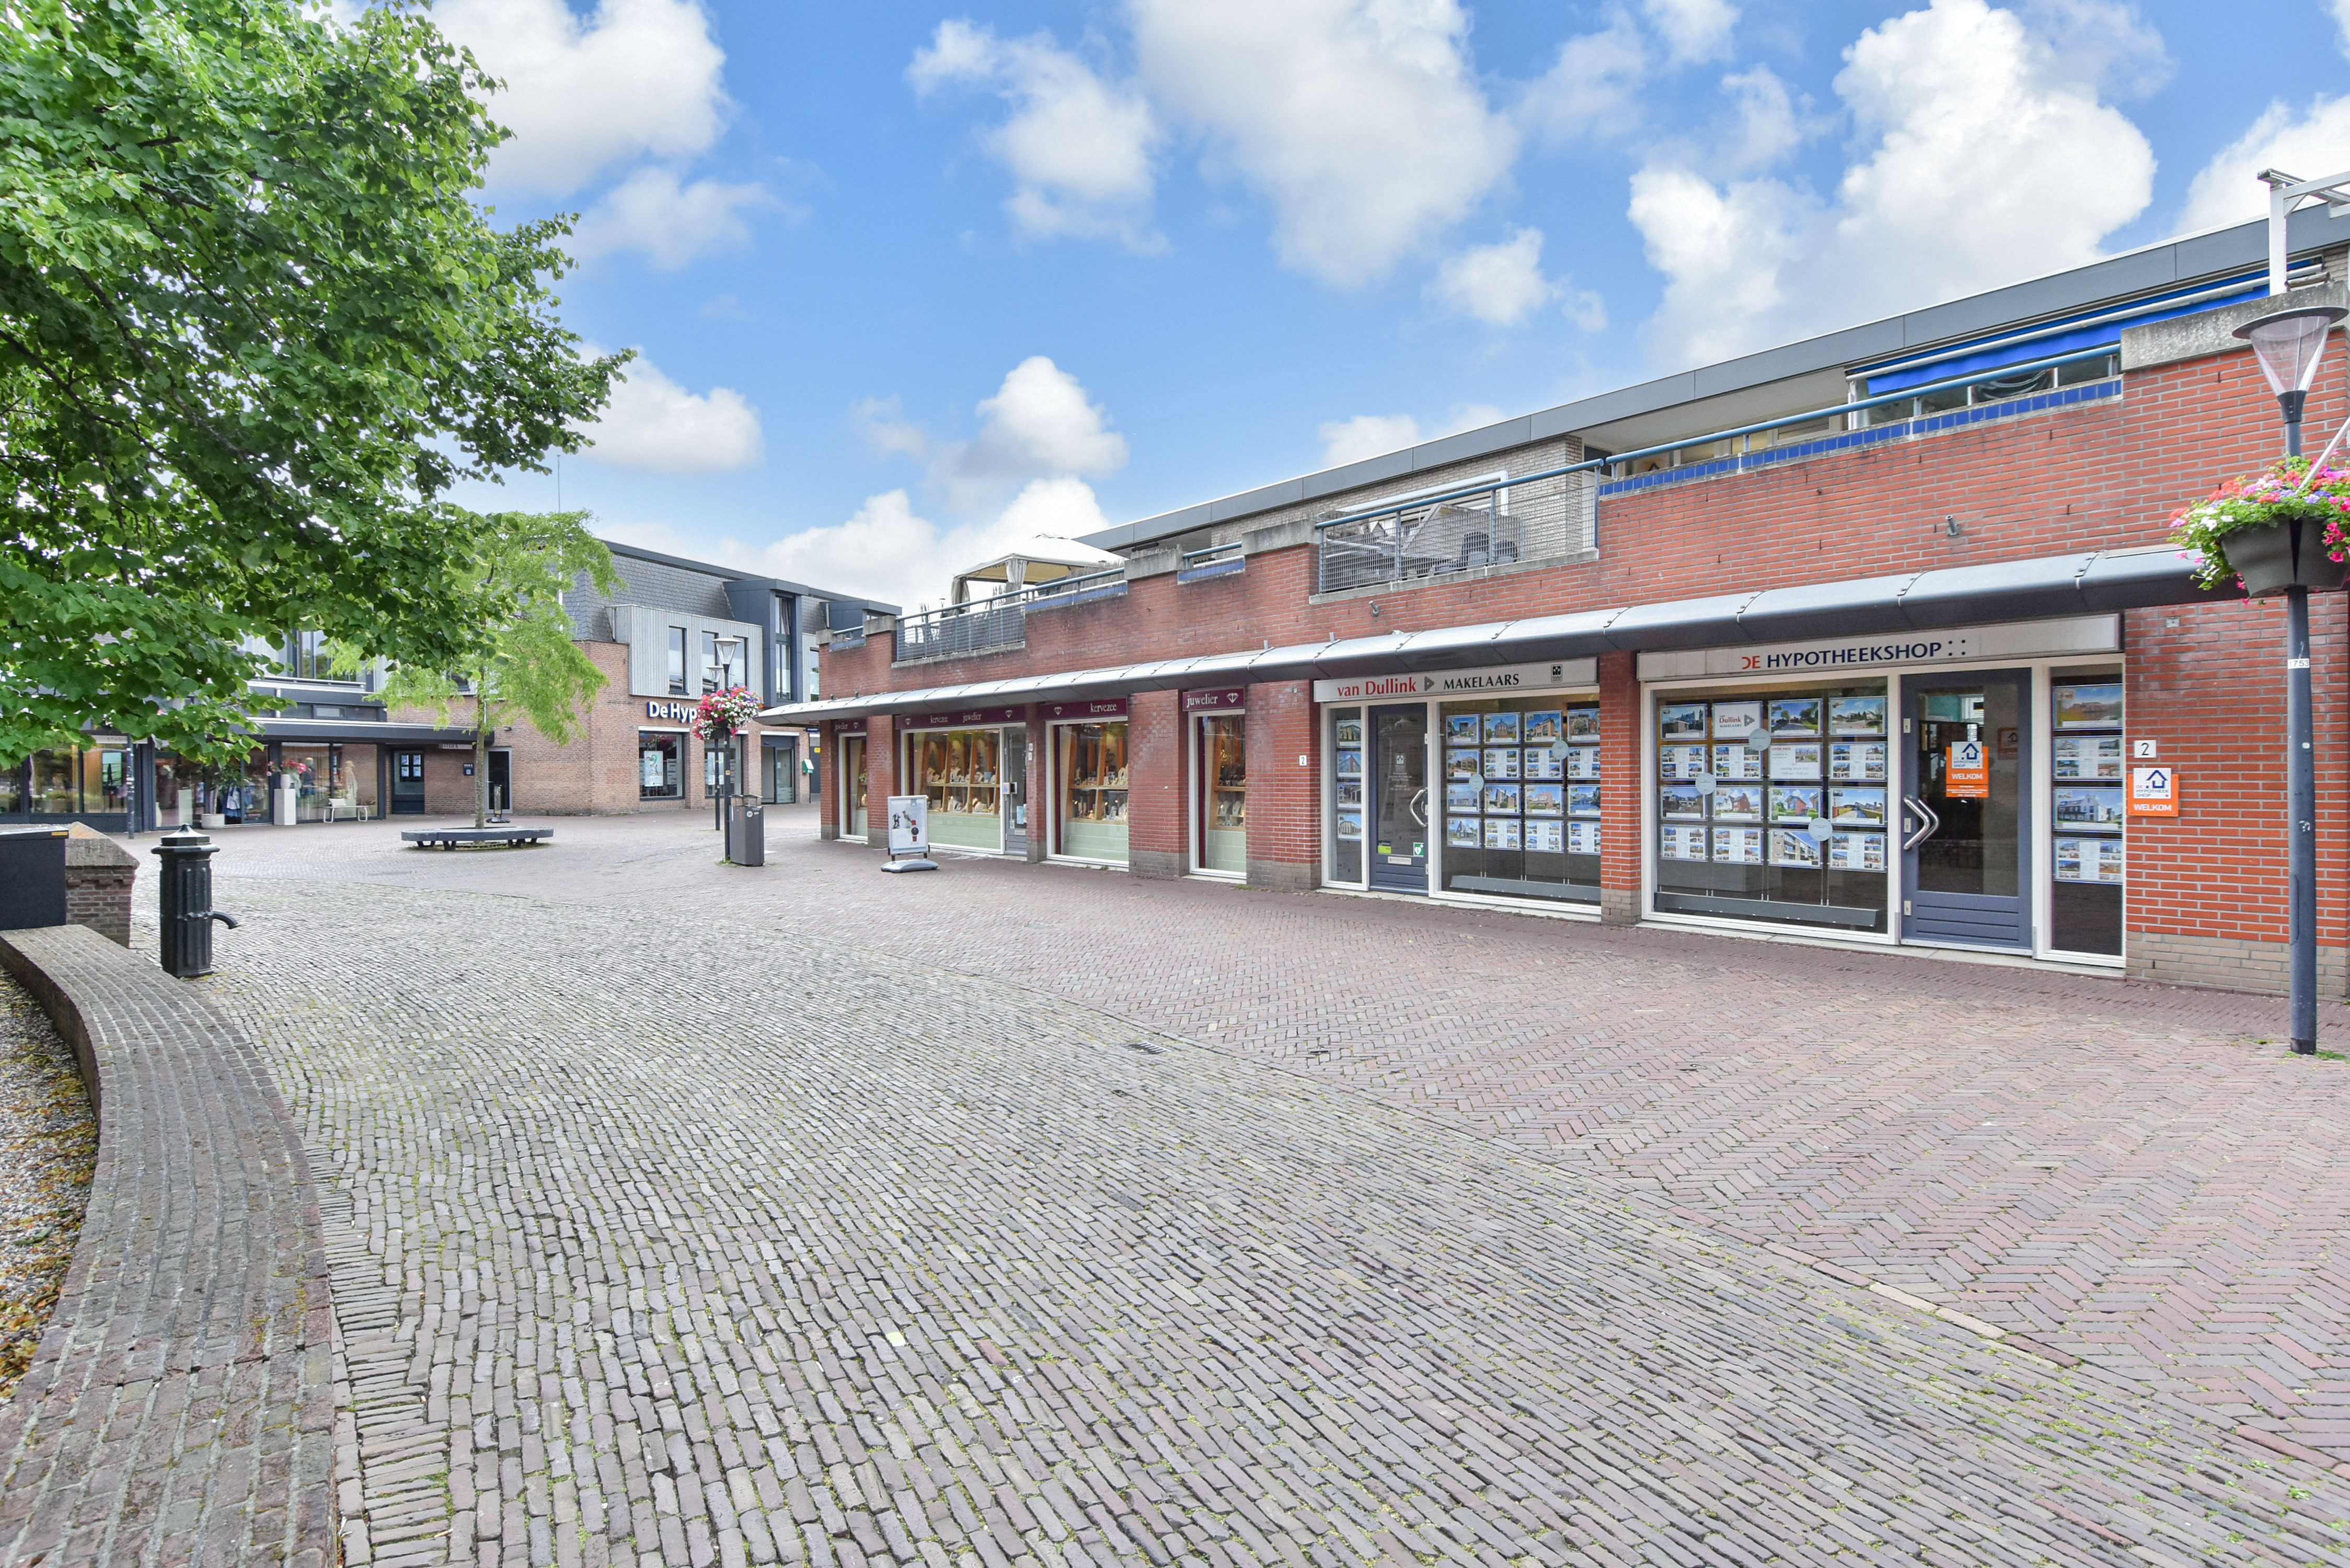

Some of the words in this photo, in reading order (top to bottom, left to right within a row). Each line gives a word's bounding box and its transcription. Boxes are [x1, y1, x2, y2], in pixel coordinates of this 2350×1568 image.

[1767, 642, 1942, 668] HYPOTHEEKSHOP
[1338, 685, 1360, 697] van
[1365, 676, 1416, 695] Dullink
[1443, 674, 1519, 690] MAKELAARS
[1186, 693, 1218, 708] juwelier
[647, 701, 668, 718] De
[669, 702, 698, 724] Hyp
[1090, 703, 1117, 713] kervezee
[930, 714, 949, 724] kervezee
[963, 711, 982, 723] juwelier
[2141, 742, 2149, 756] 2
[1301, 756, 1305, 765] 2
[2133, 803, 2172, 812] WELKOM
